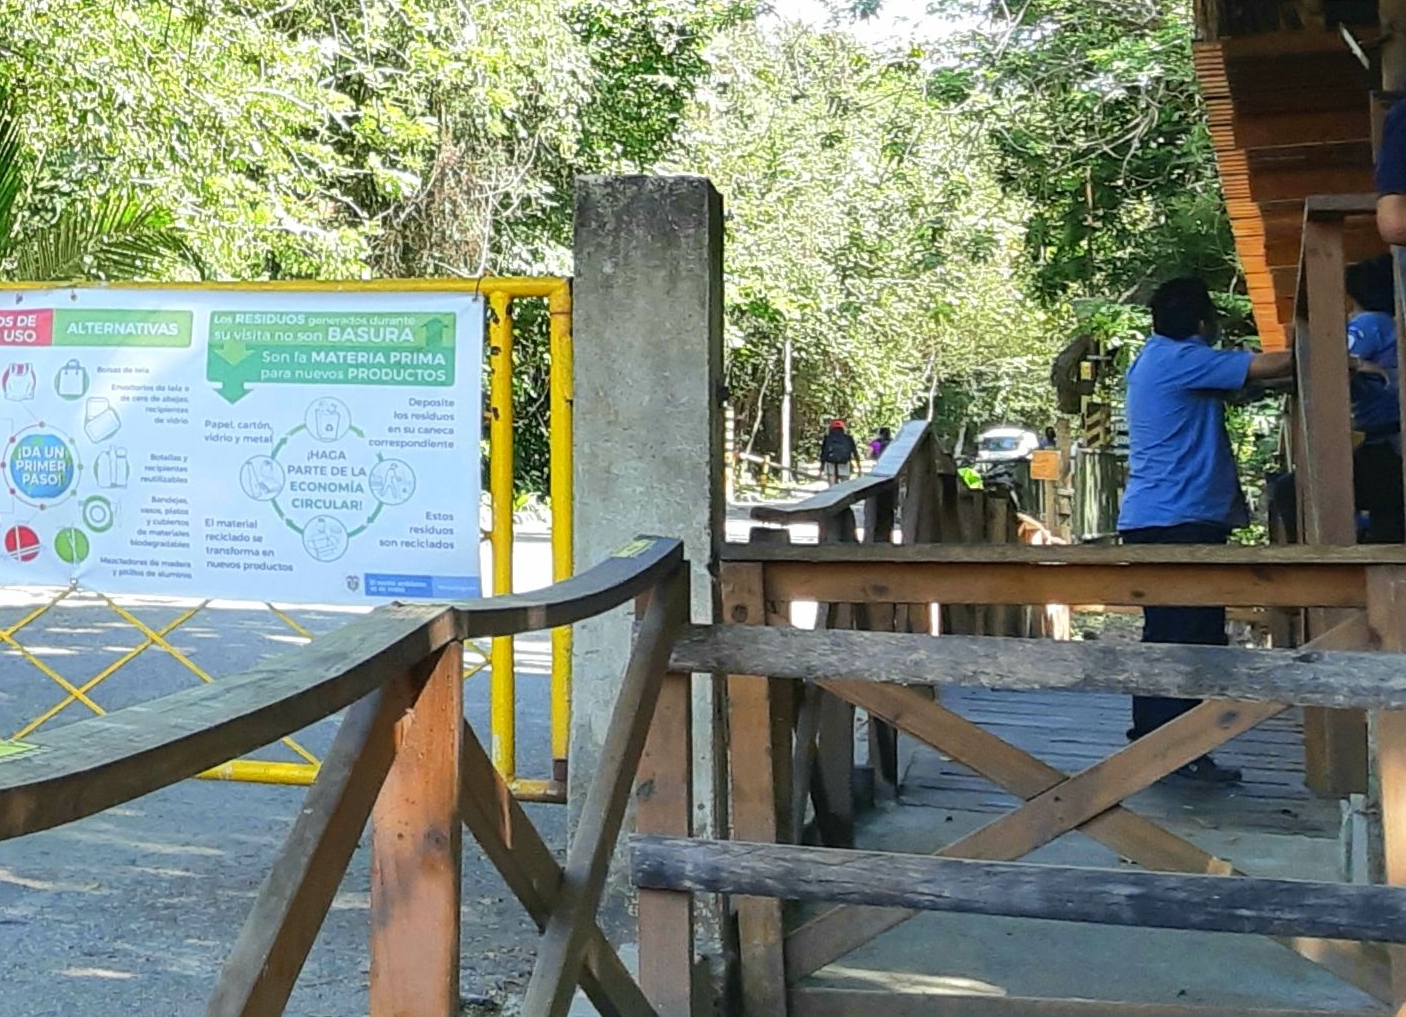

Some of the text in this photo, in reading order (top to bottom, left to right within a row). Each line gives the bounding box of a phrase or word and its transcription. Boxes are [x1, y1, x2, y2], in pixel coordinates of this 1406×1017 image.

[16, 314, 37, 328] DE
[214, 314, 415, 329] Los RESIDUOS generados durante
[66, 321, 179, 336] ALTERNATIVAS
[4, 330, 37, 343] USO
[214, 327, 414, 343] su visita no son BASURA
[261, 351, 446, 366] Son la MATERIA PRIMA
[260, 368, 446, 382] para nuevos PRODUCTOS
[408, 398, 455, 410] Deposite
[394, 411, 455, 421] los residuos
[388, 426, 454, 435] en su caneca
[204, 433, 233, 443] vidrio
[242, 433, 272, 443] metal
[368, 438, 455, 449] correspondiente
[17, 446, 66, 460] ¡DA UN
[307, 450, 346, 462] ¡HAGA
[15, 460, 67, 472] PRIMER
[288, 465, 367, 477] PARTE DE LA
[21, 472, 64, 486] PASO!
[289, 479, 365, 493] ECONOMÍA
[291, 498, 363, 511] CIRCULAR!
[425, 511, 454, 521] Estos
[205, 518, 257, 529] El material
[409, 524, 454, 535] residuos
[205, 532, 263, 543] reciclado se
[379, 538, 455, 550] son reciclados
[206, 546, 275, 557] transforma en
[206, 560, 294, 573] nuevos productos
